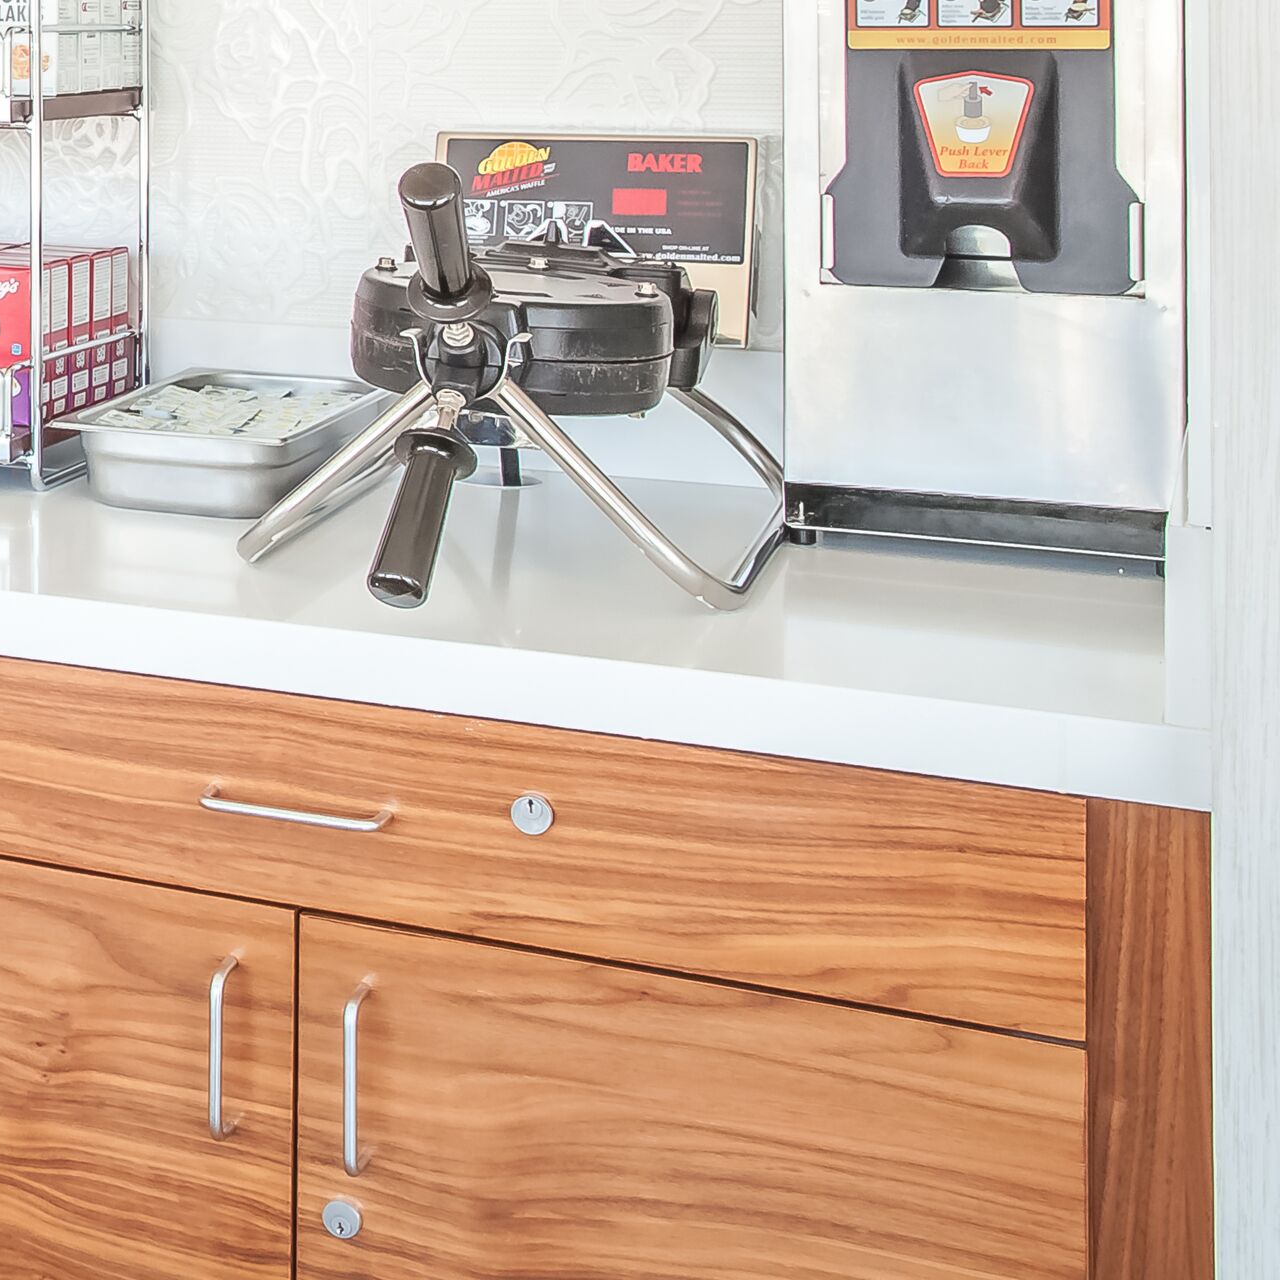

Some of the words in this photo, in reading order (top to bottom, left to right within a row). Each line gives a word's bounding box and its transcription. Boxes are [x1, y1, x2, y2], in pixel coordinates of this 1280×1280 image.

[896, 34, 1057, 46] www.goldenmalted.com
[940, 146, 969, 156] Push
[974, 146, 1008, 156] Lever
[478, 146, 551, 175] GOLDEN
[627, 153, 702, 173] BAKER
[959, 159, 989, 169] Back
[471, 162, 544, 191] MALTED
[486, 185, 520, 197] AMERICA'S
[521, 180, 545, 190] WAFFLE
